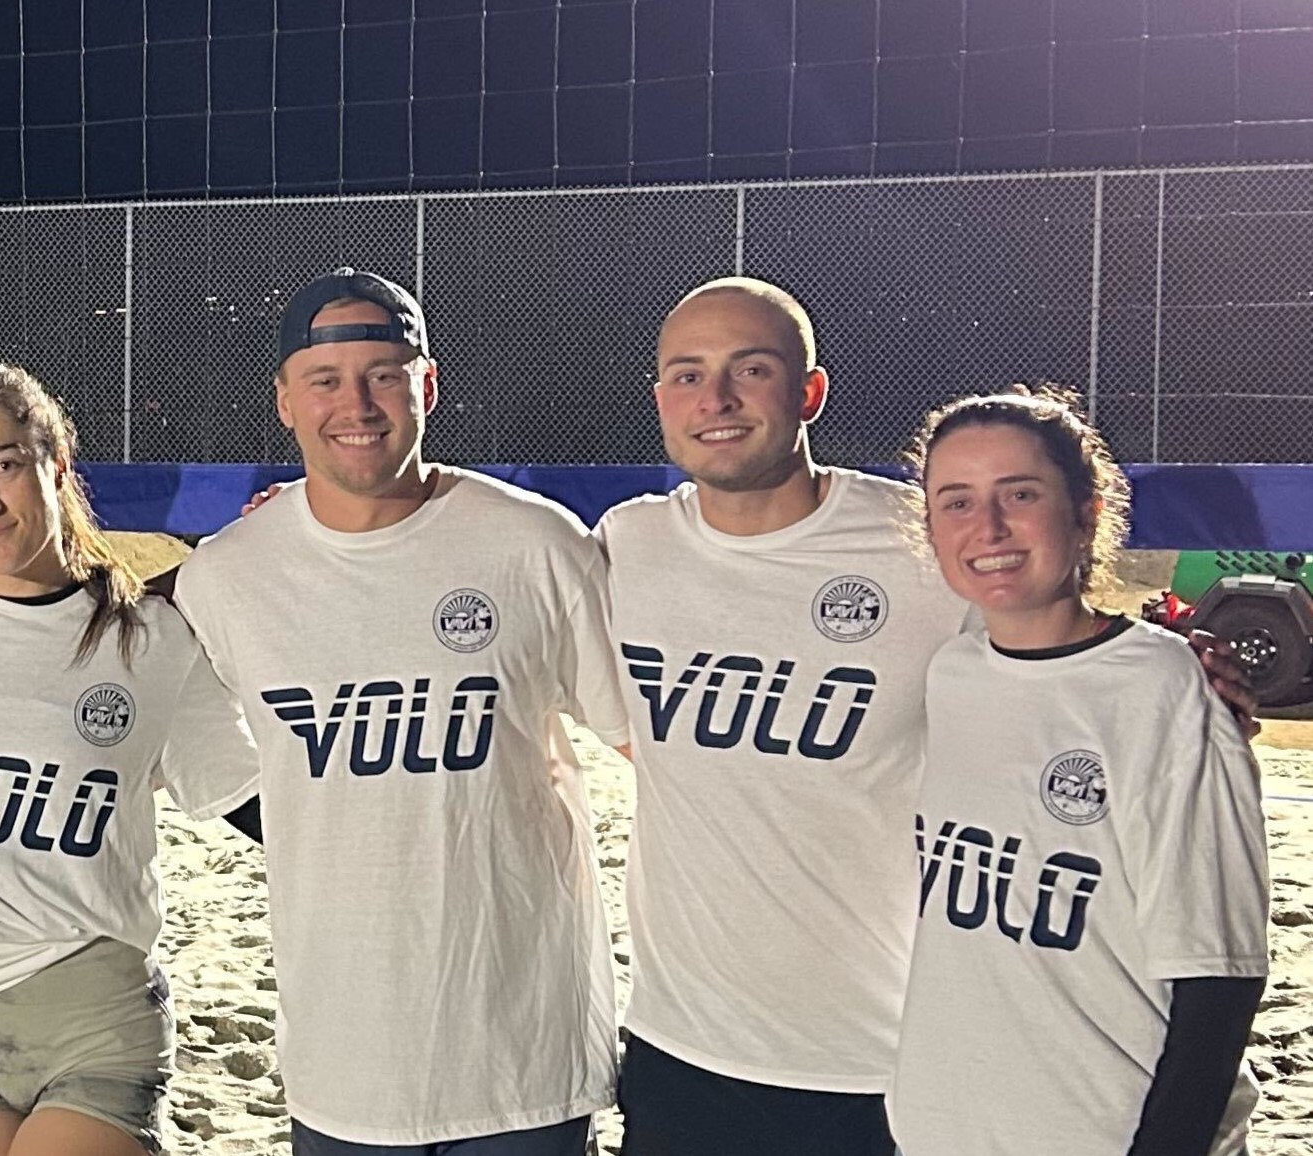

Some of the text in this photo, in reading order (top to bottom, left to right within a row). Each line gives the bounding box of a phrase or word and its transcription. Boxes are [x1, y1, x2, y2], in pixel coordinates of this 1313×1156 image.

[260, 676, 500, 778] VOLO
[620, 642, 877, 760] VOLO
[915, 813, 1102, 951] VOLO
